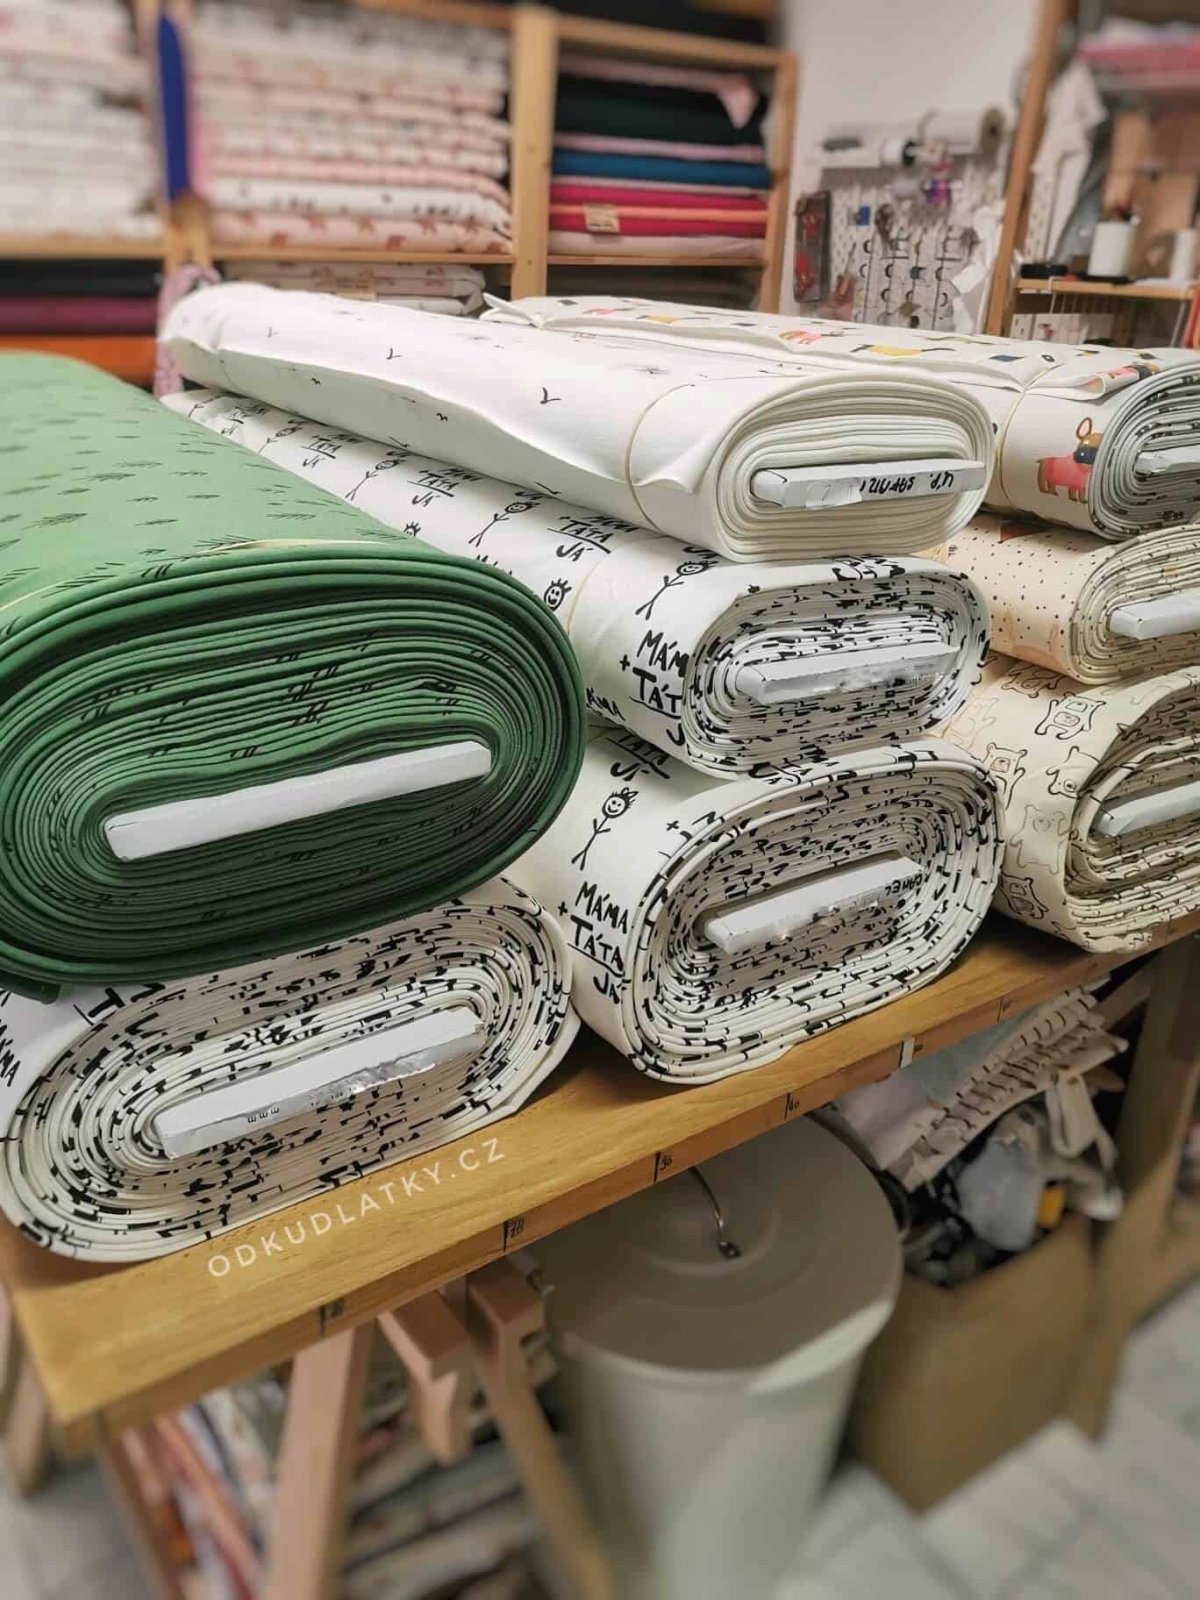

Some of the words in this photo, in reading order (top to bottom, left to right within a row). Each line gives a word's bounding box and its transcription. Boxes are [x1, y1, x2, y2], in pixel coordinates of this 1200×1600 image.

[632, 667, 683, 713] TÁT
[575, 881, 629, 934] MÁMA
[570, 914, 625, 972] TÁTA
